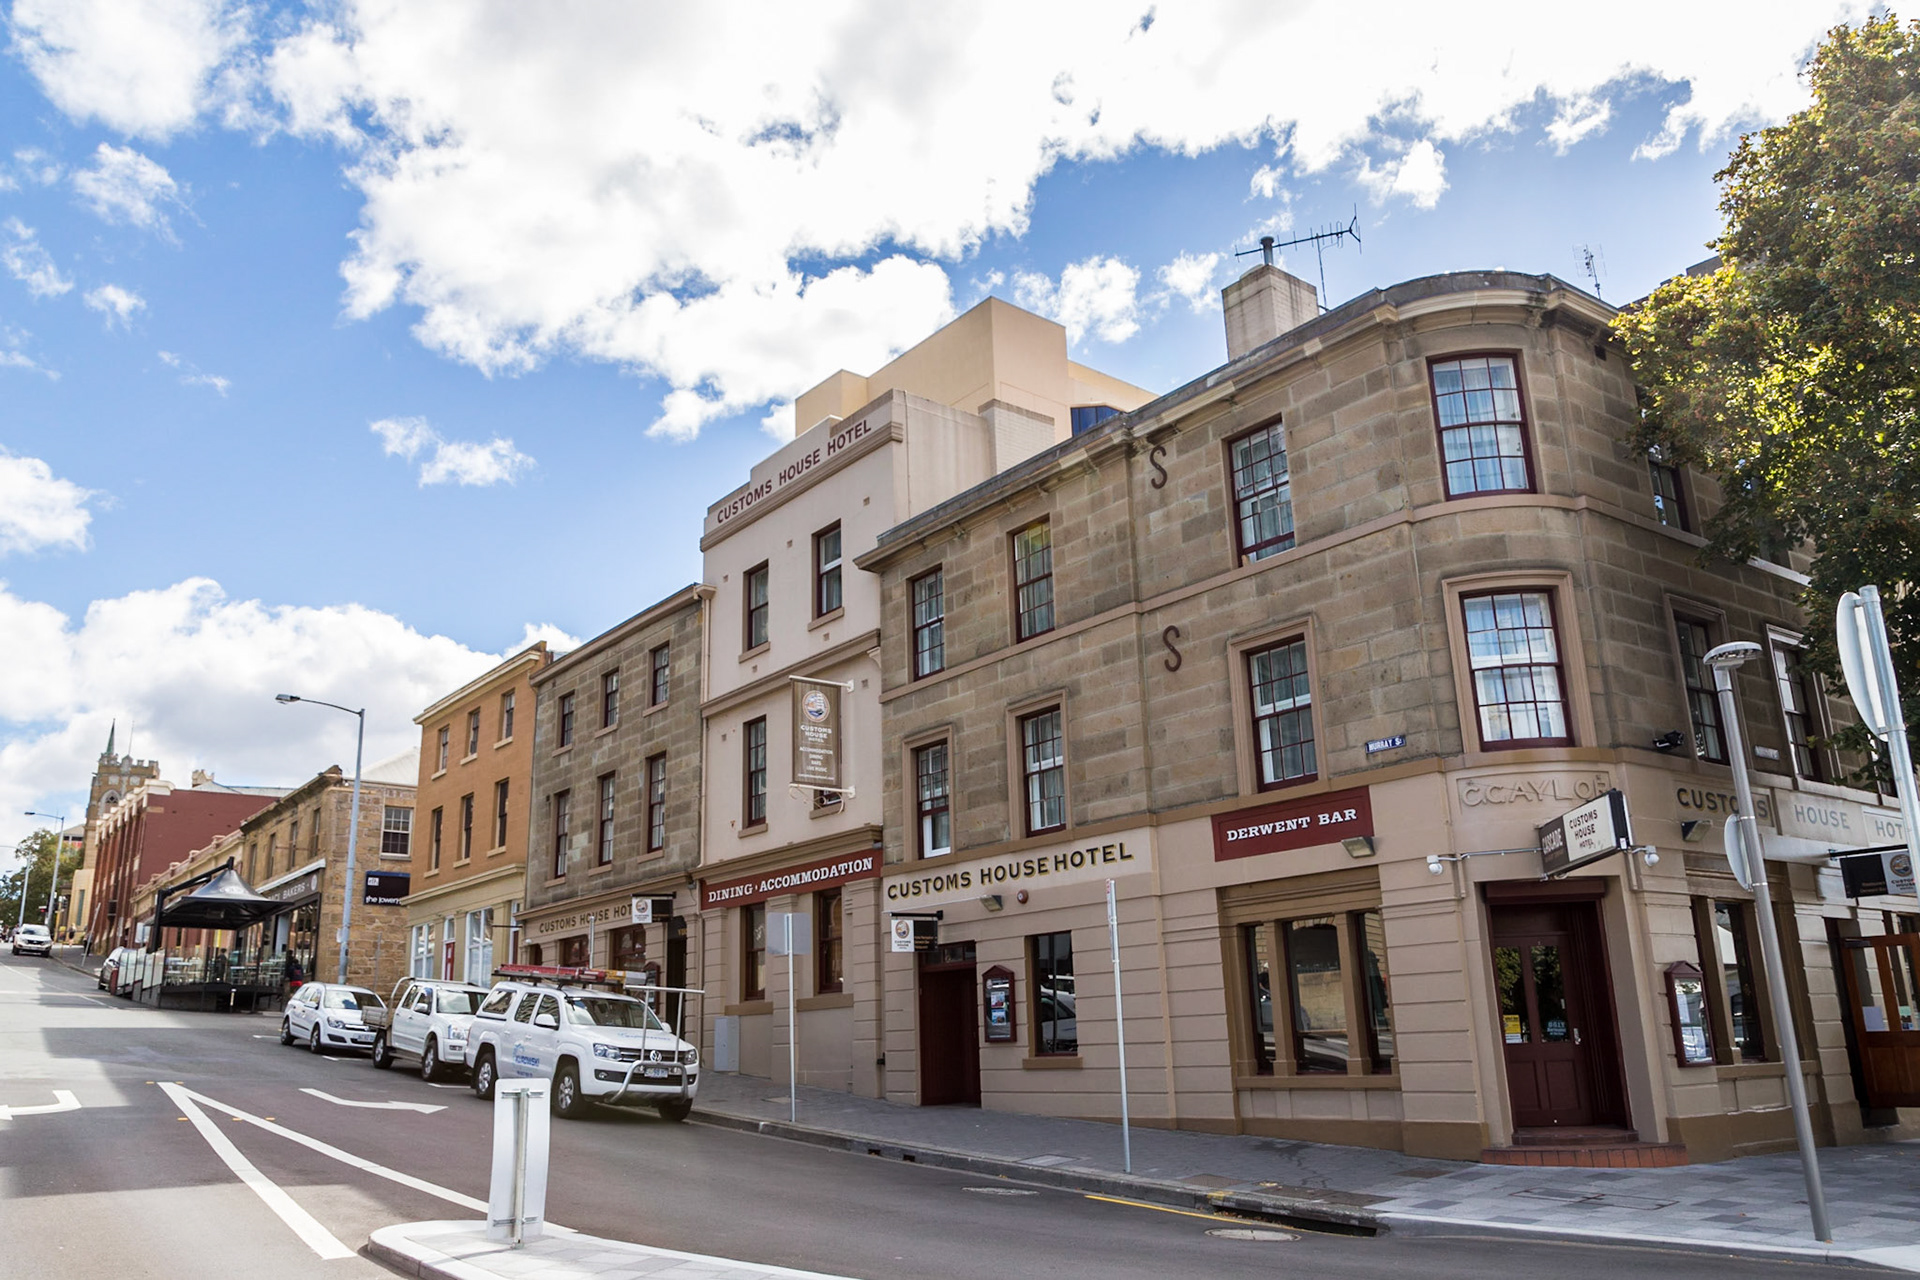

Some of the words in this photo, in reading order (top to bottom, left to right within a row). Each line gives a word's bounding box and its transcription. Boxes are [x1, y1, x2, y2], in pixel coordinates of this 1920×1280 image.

[717, 479, 773, 524] CUSTOMS
[779, 448, 821, 487] HOUSE
[827, 419, 872, 457] HOTEL
[1368, 738, 1393, 752] MURRAY
[1676, 787, 1769, 819] CUSTOS
[1794, 803, 1851, 830] HOUSE
[1226, 816, 1311, 842] DERWENT
[1318, 808, 1357, 826] BAR
[1569, 809, 1598, 829] CUSTOMS
[1541, 827, 1564, 855] CASCADE
[1574, 825, 1596, 841] HOUSE
[1579, 838, 1594, 849] HOTEL
[708, 883, 753, 903] DINING
[759, 857, 873, 893] ACCOMMODATION
[887, 871, 972, 900] CUSTOMS
[980, 856, 1050, 885] HOUSE
[1054, 842, 1135, 872] HOTEL
[539, 916, 577, 934] CUSTOMS
[579, 908, 610, 926] HOUSE
